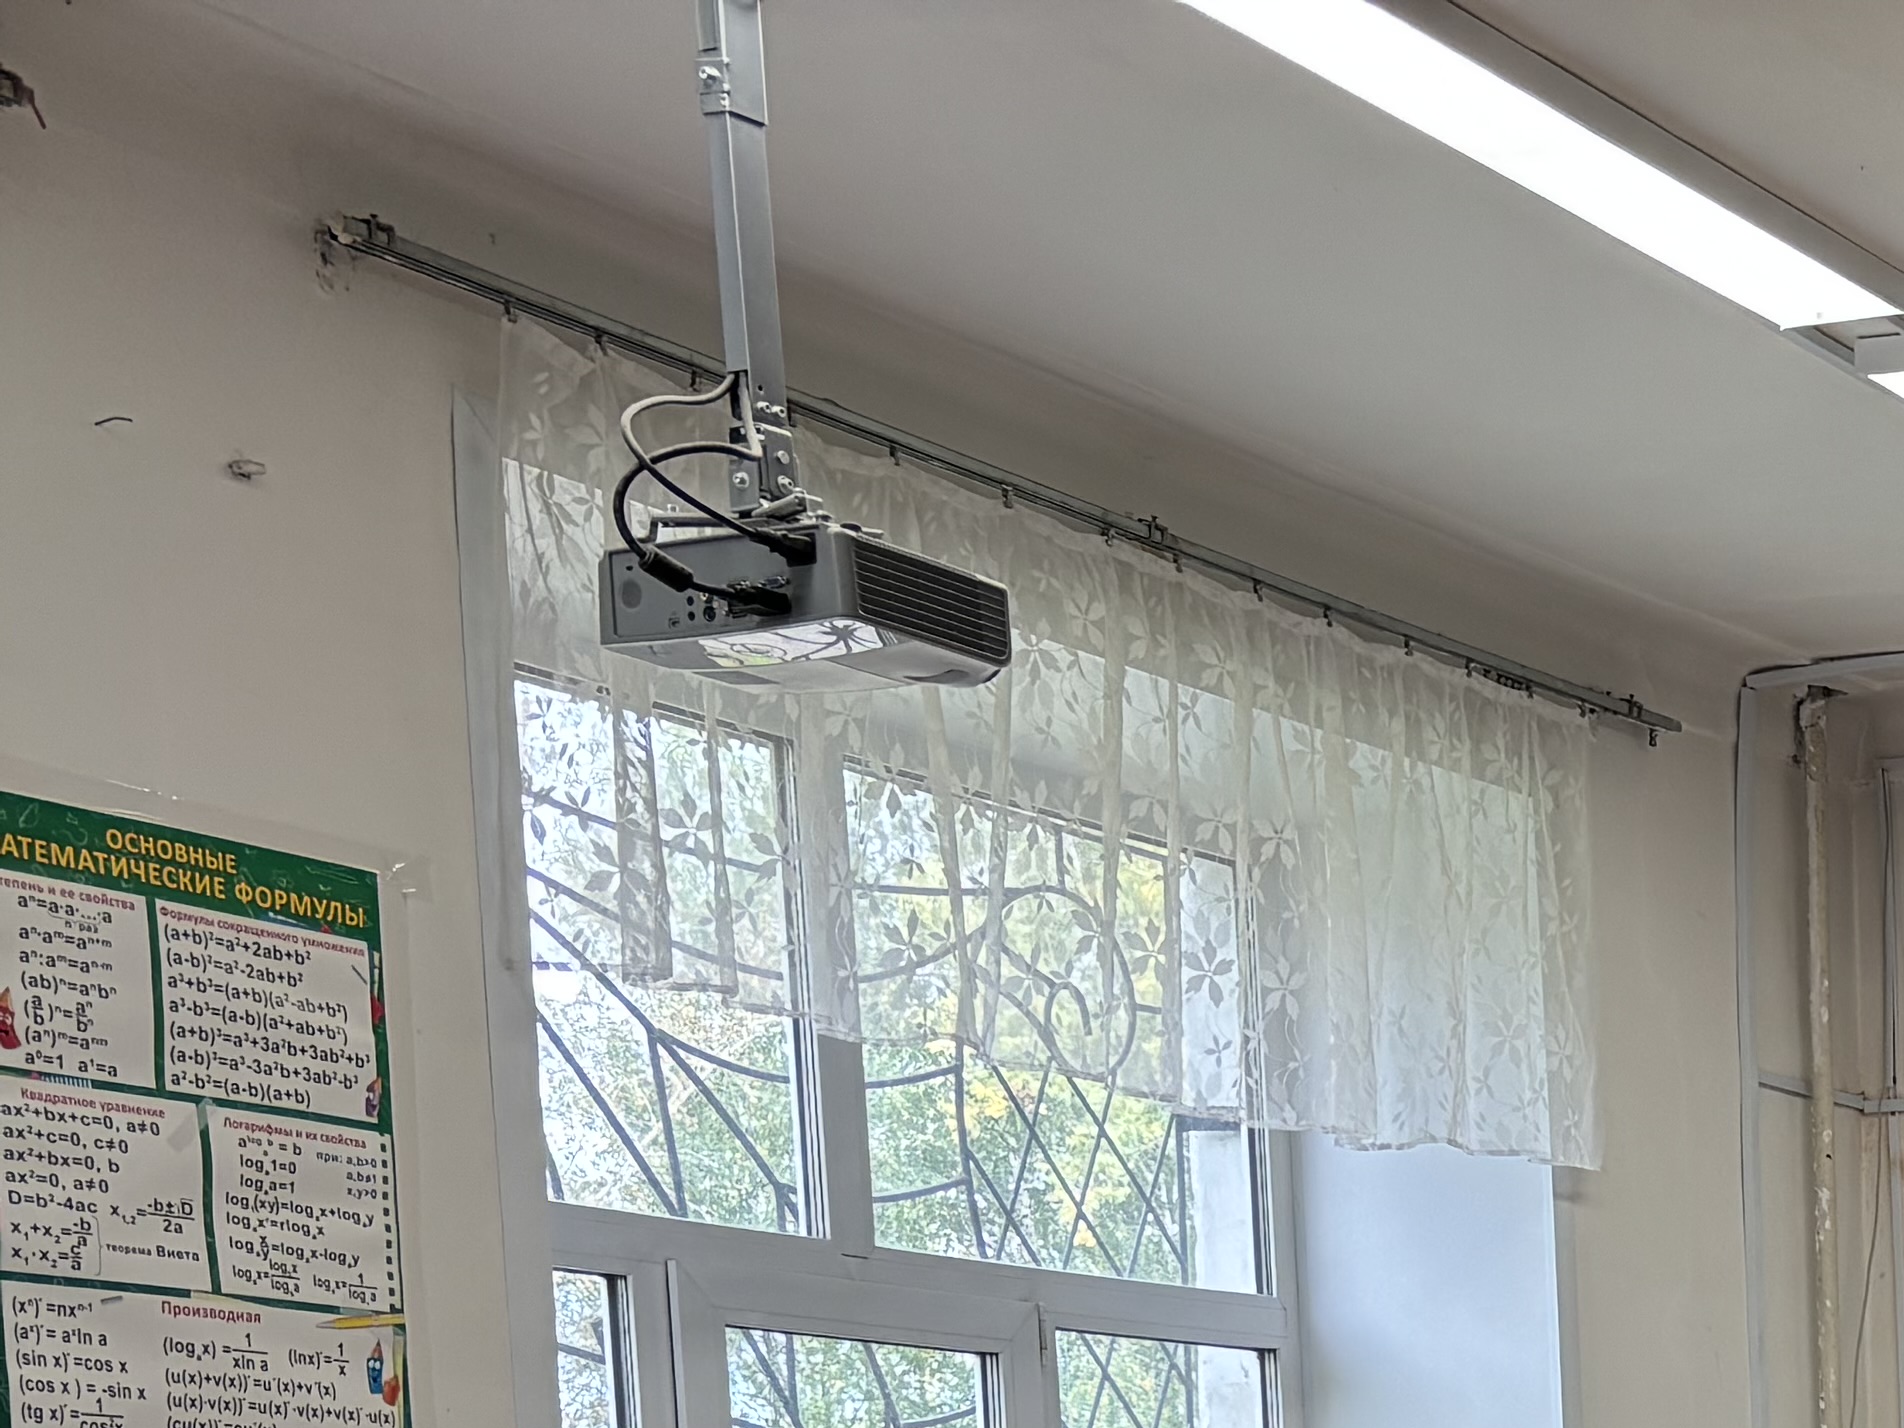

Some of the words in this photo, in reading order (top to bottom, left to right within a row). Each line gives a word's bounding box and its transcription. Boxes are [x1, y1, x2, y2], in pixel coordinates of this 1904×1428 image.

[105, 828, 237, 875] ОСНОВНЫЕ
[0, 833, 226, 899] АТЕМАТИЧЕСКИЕ
[235, 881, 365, 928] ФОРМУЛЫ
[161, 1301, 261, 1324] Производная
